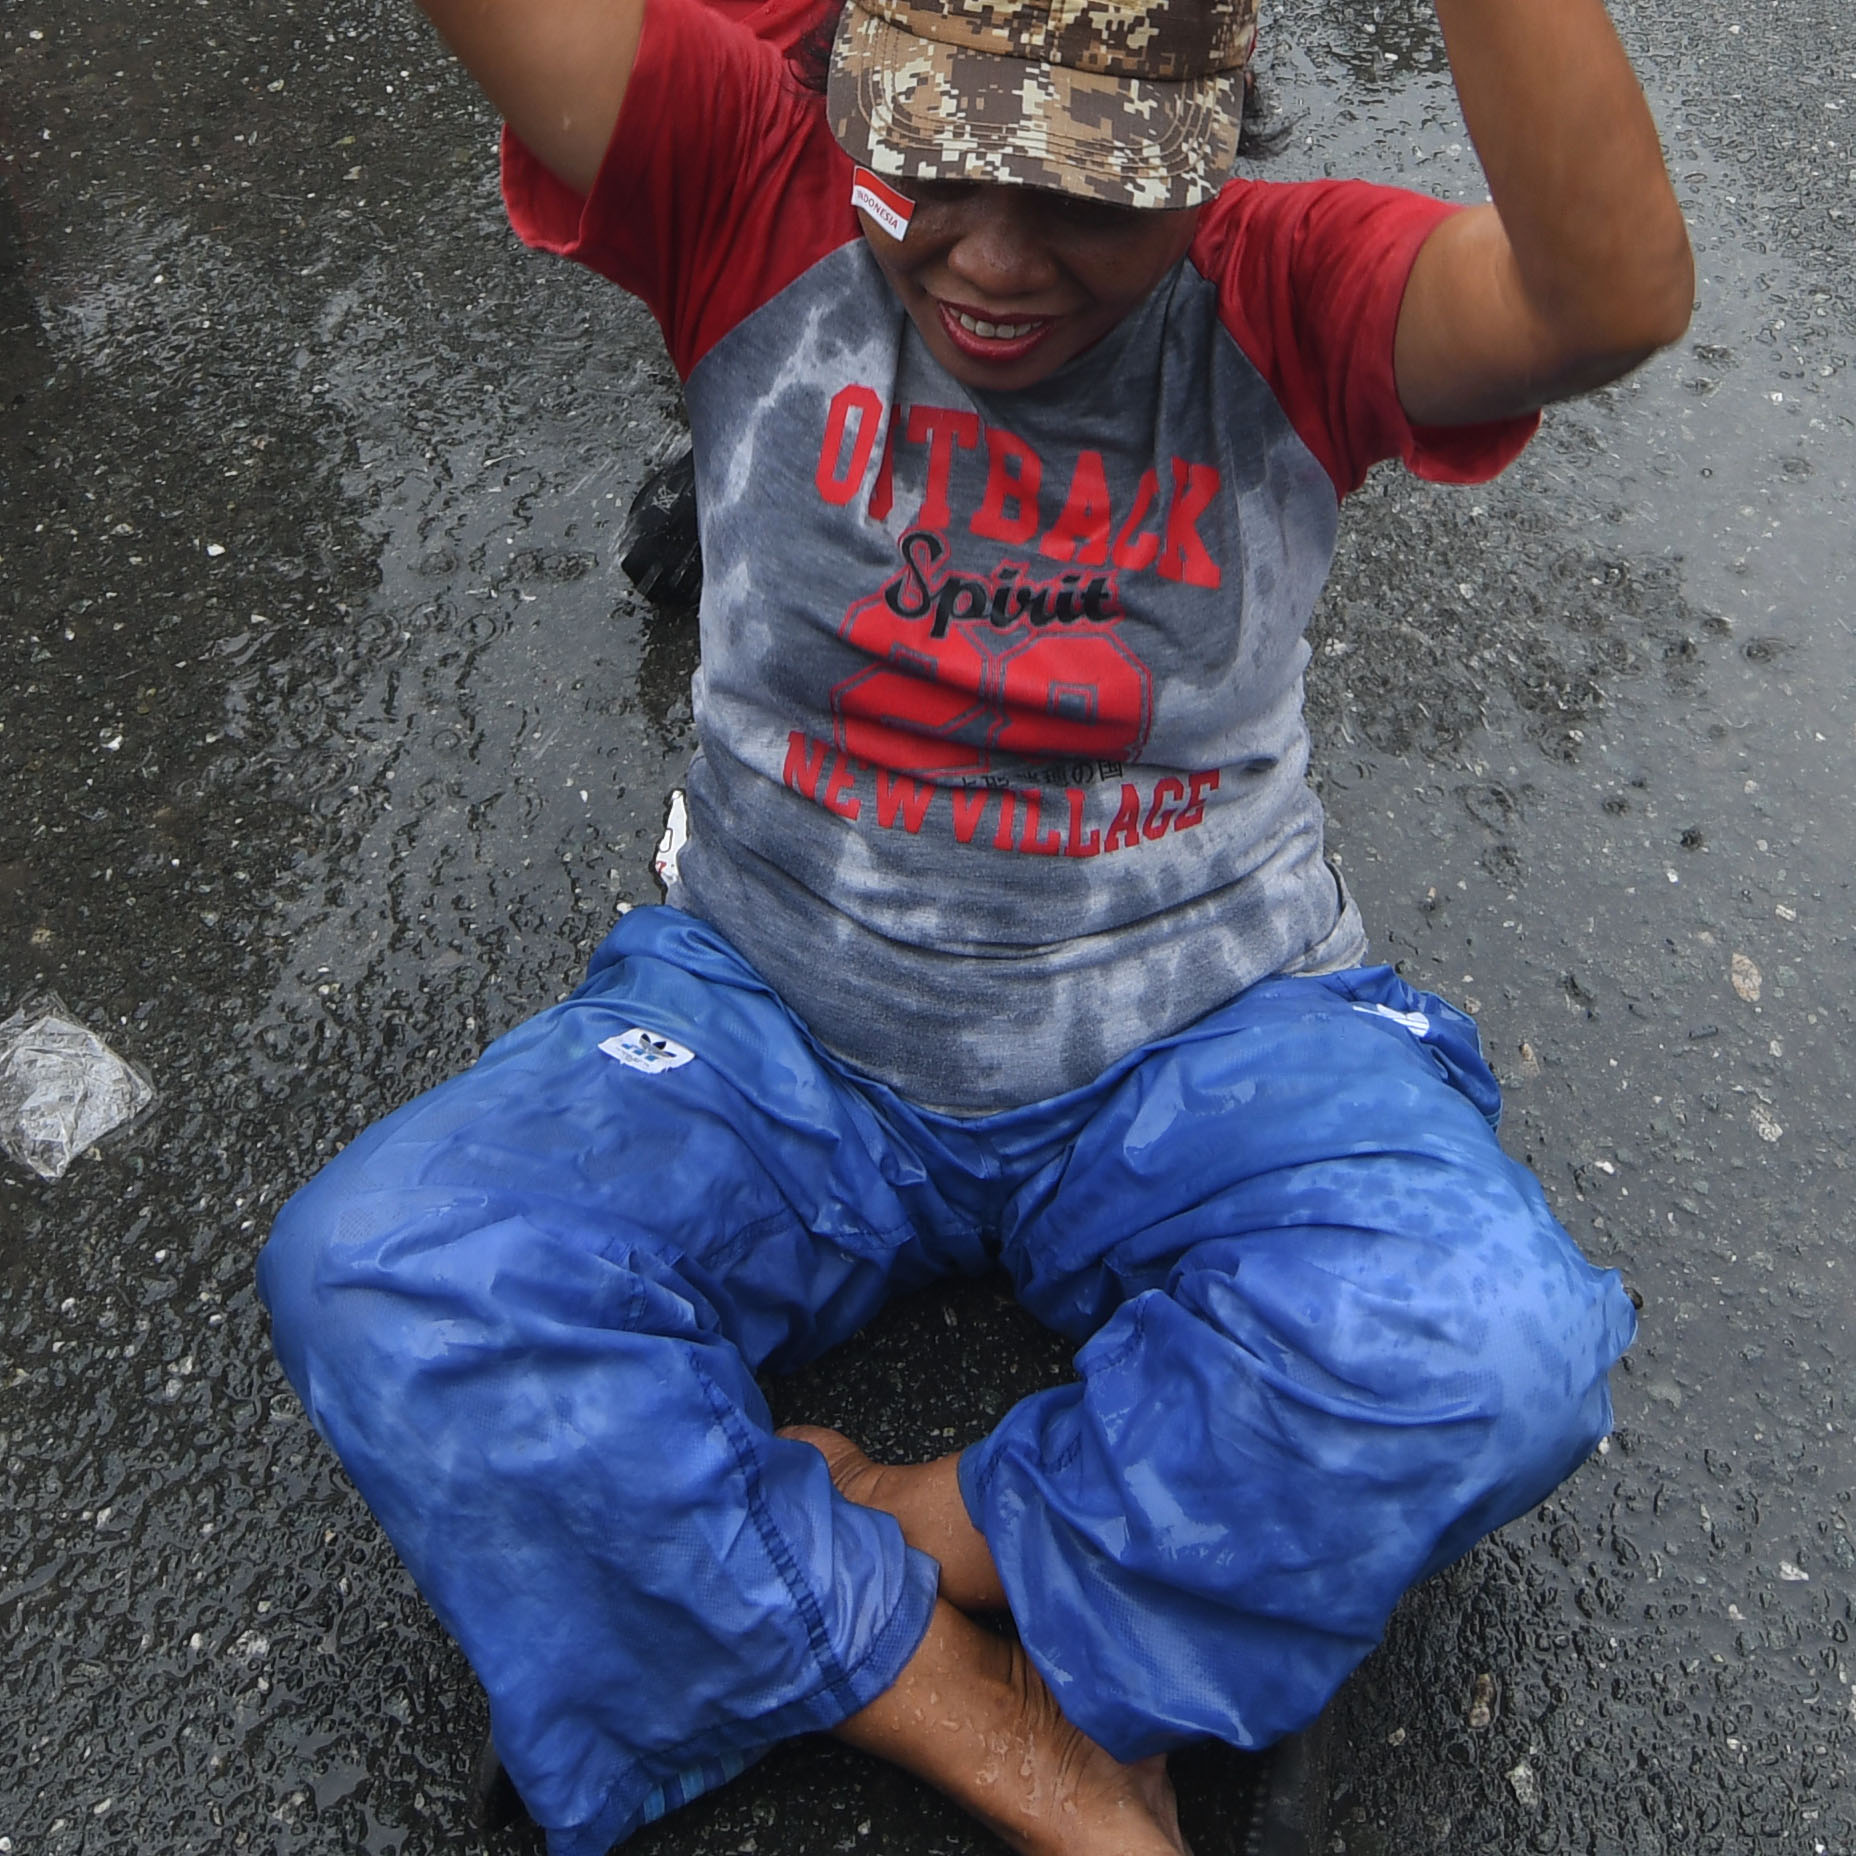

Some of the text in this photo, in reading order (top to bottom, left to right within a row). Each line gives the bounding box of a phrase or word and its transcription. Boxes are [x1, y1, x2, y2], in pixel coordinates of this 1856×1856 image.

[856, 189, 899, 230] INDONESIA
[885, 528, 1122, 639] Spirit
[951, 768, 1220, 858] VILLAGE
